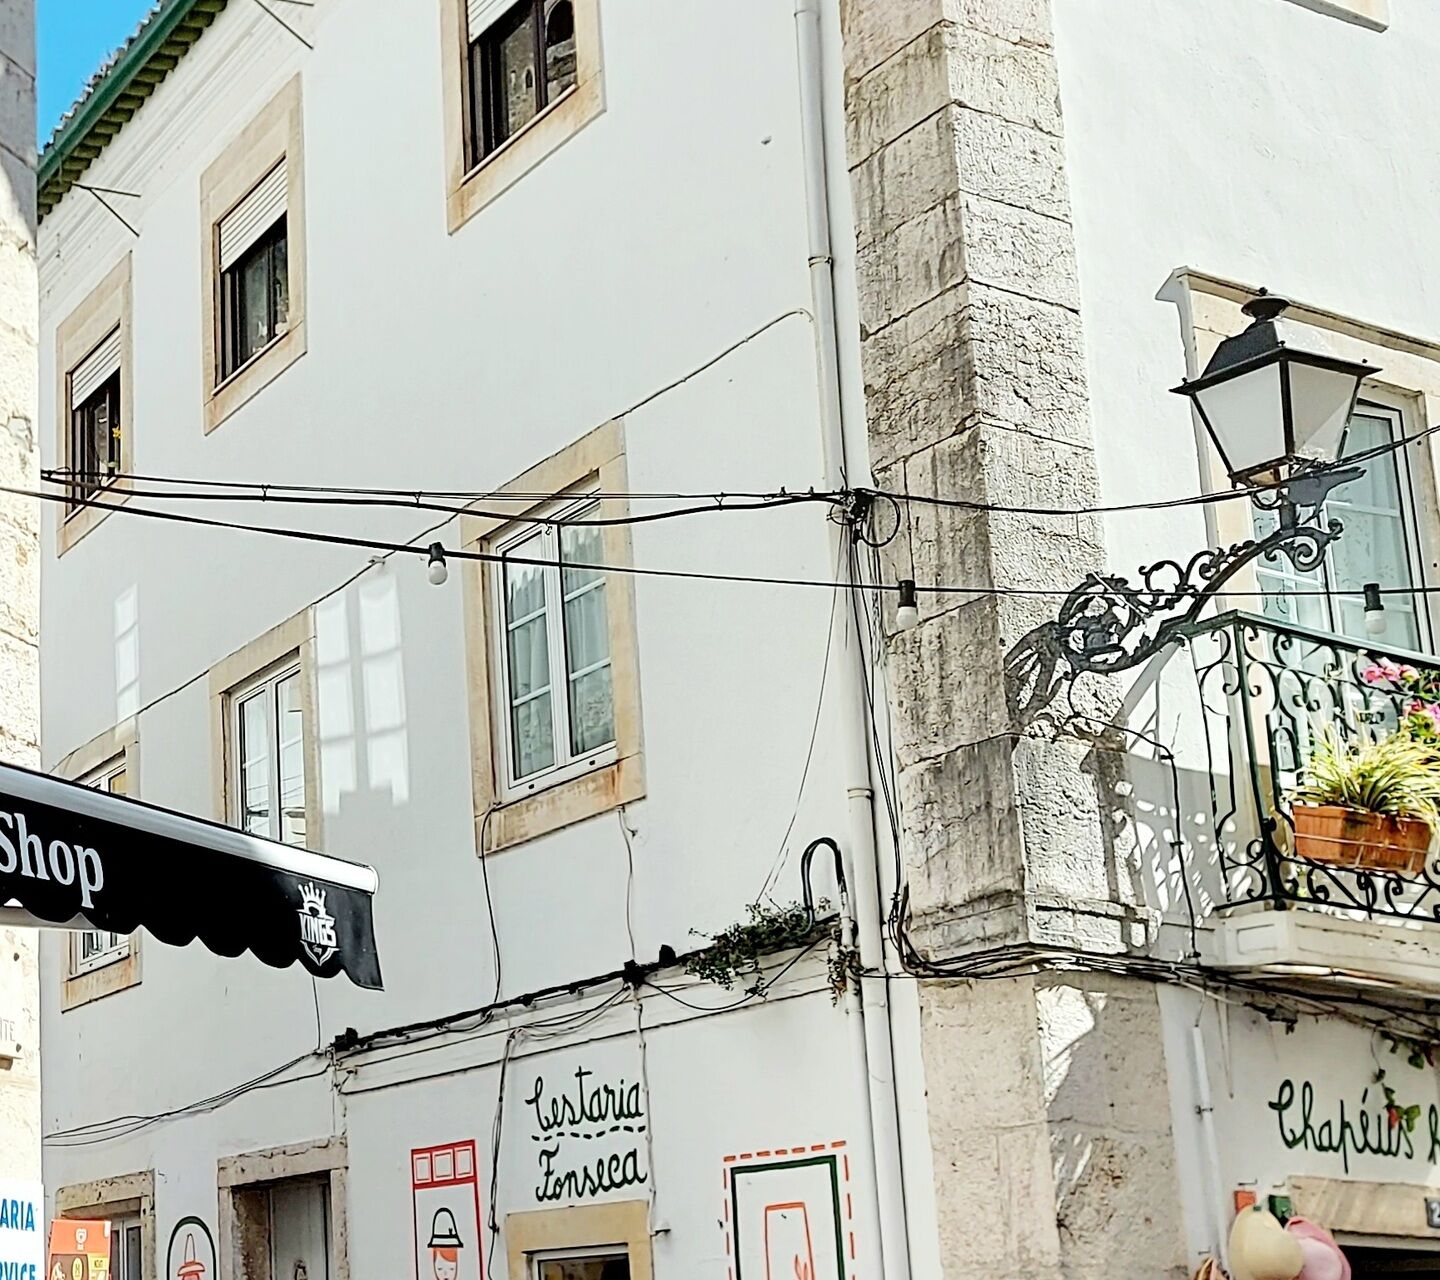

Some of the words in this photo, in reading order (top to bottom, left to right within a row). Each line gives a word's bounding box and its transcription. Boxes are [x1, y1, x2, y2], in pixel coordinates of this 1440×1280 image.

[299, 913, 336, 947] KINGS
[525, 1065, 644, 1132] Cestaria
[1268, 1079, 1414, 1175] Chapéus
[536, 1142, 648, 1202] Fonseca
